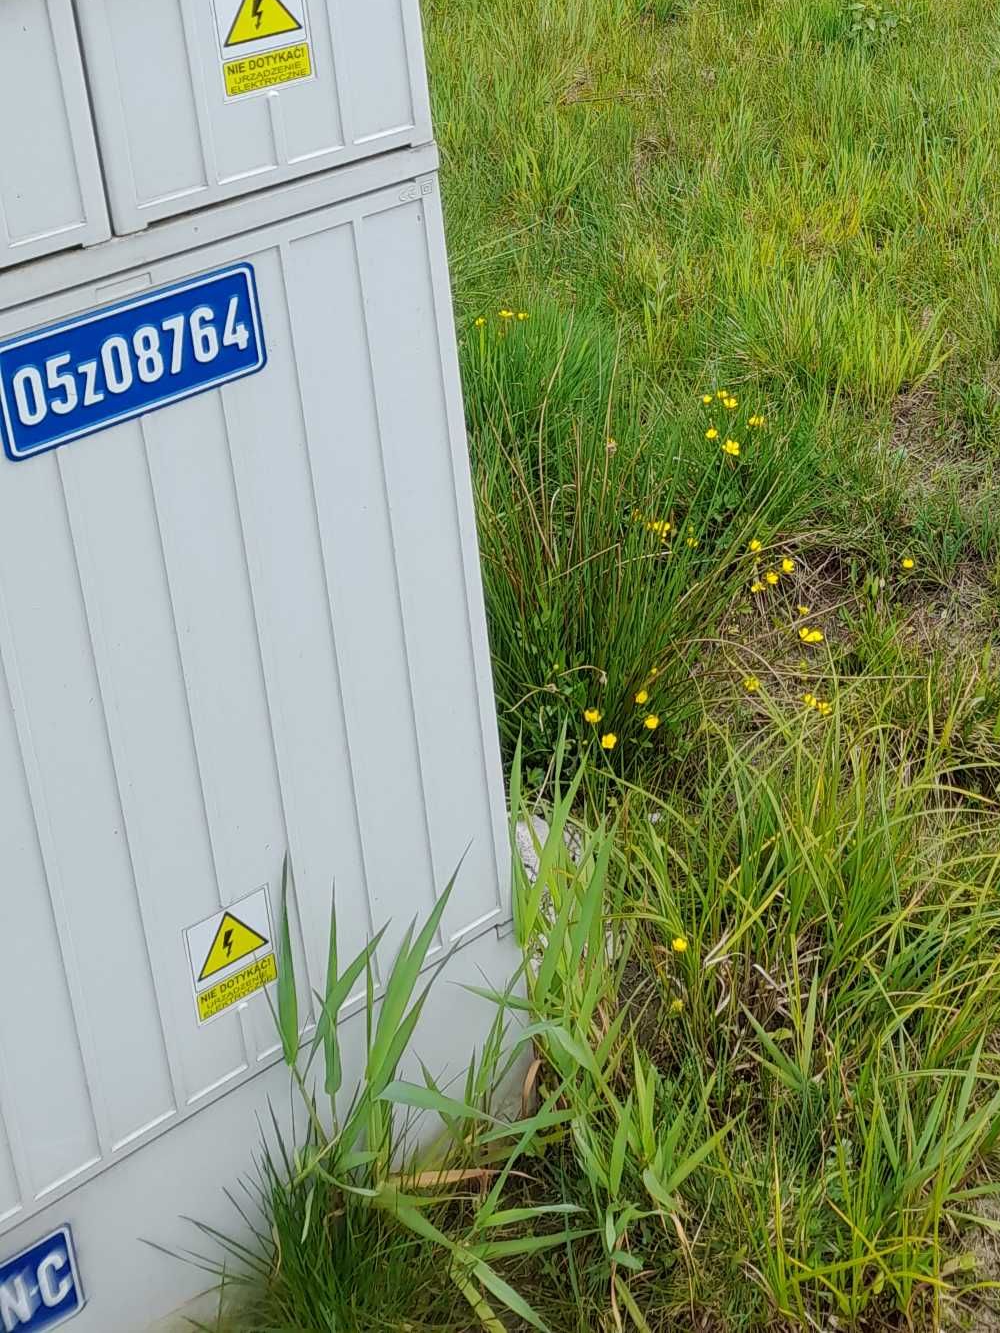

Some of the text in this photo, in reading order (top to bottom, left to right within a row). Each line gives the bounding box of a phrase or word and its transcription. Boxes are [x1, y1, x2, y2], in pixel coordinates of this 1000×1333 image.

[227, 46, 305, 75] NIE DOTYKAĆ!
[12, 296, 249, 426] 05z08764
[200, 988, 217, 1004] NIE
